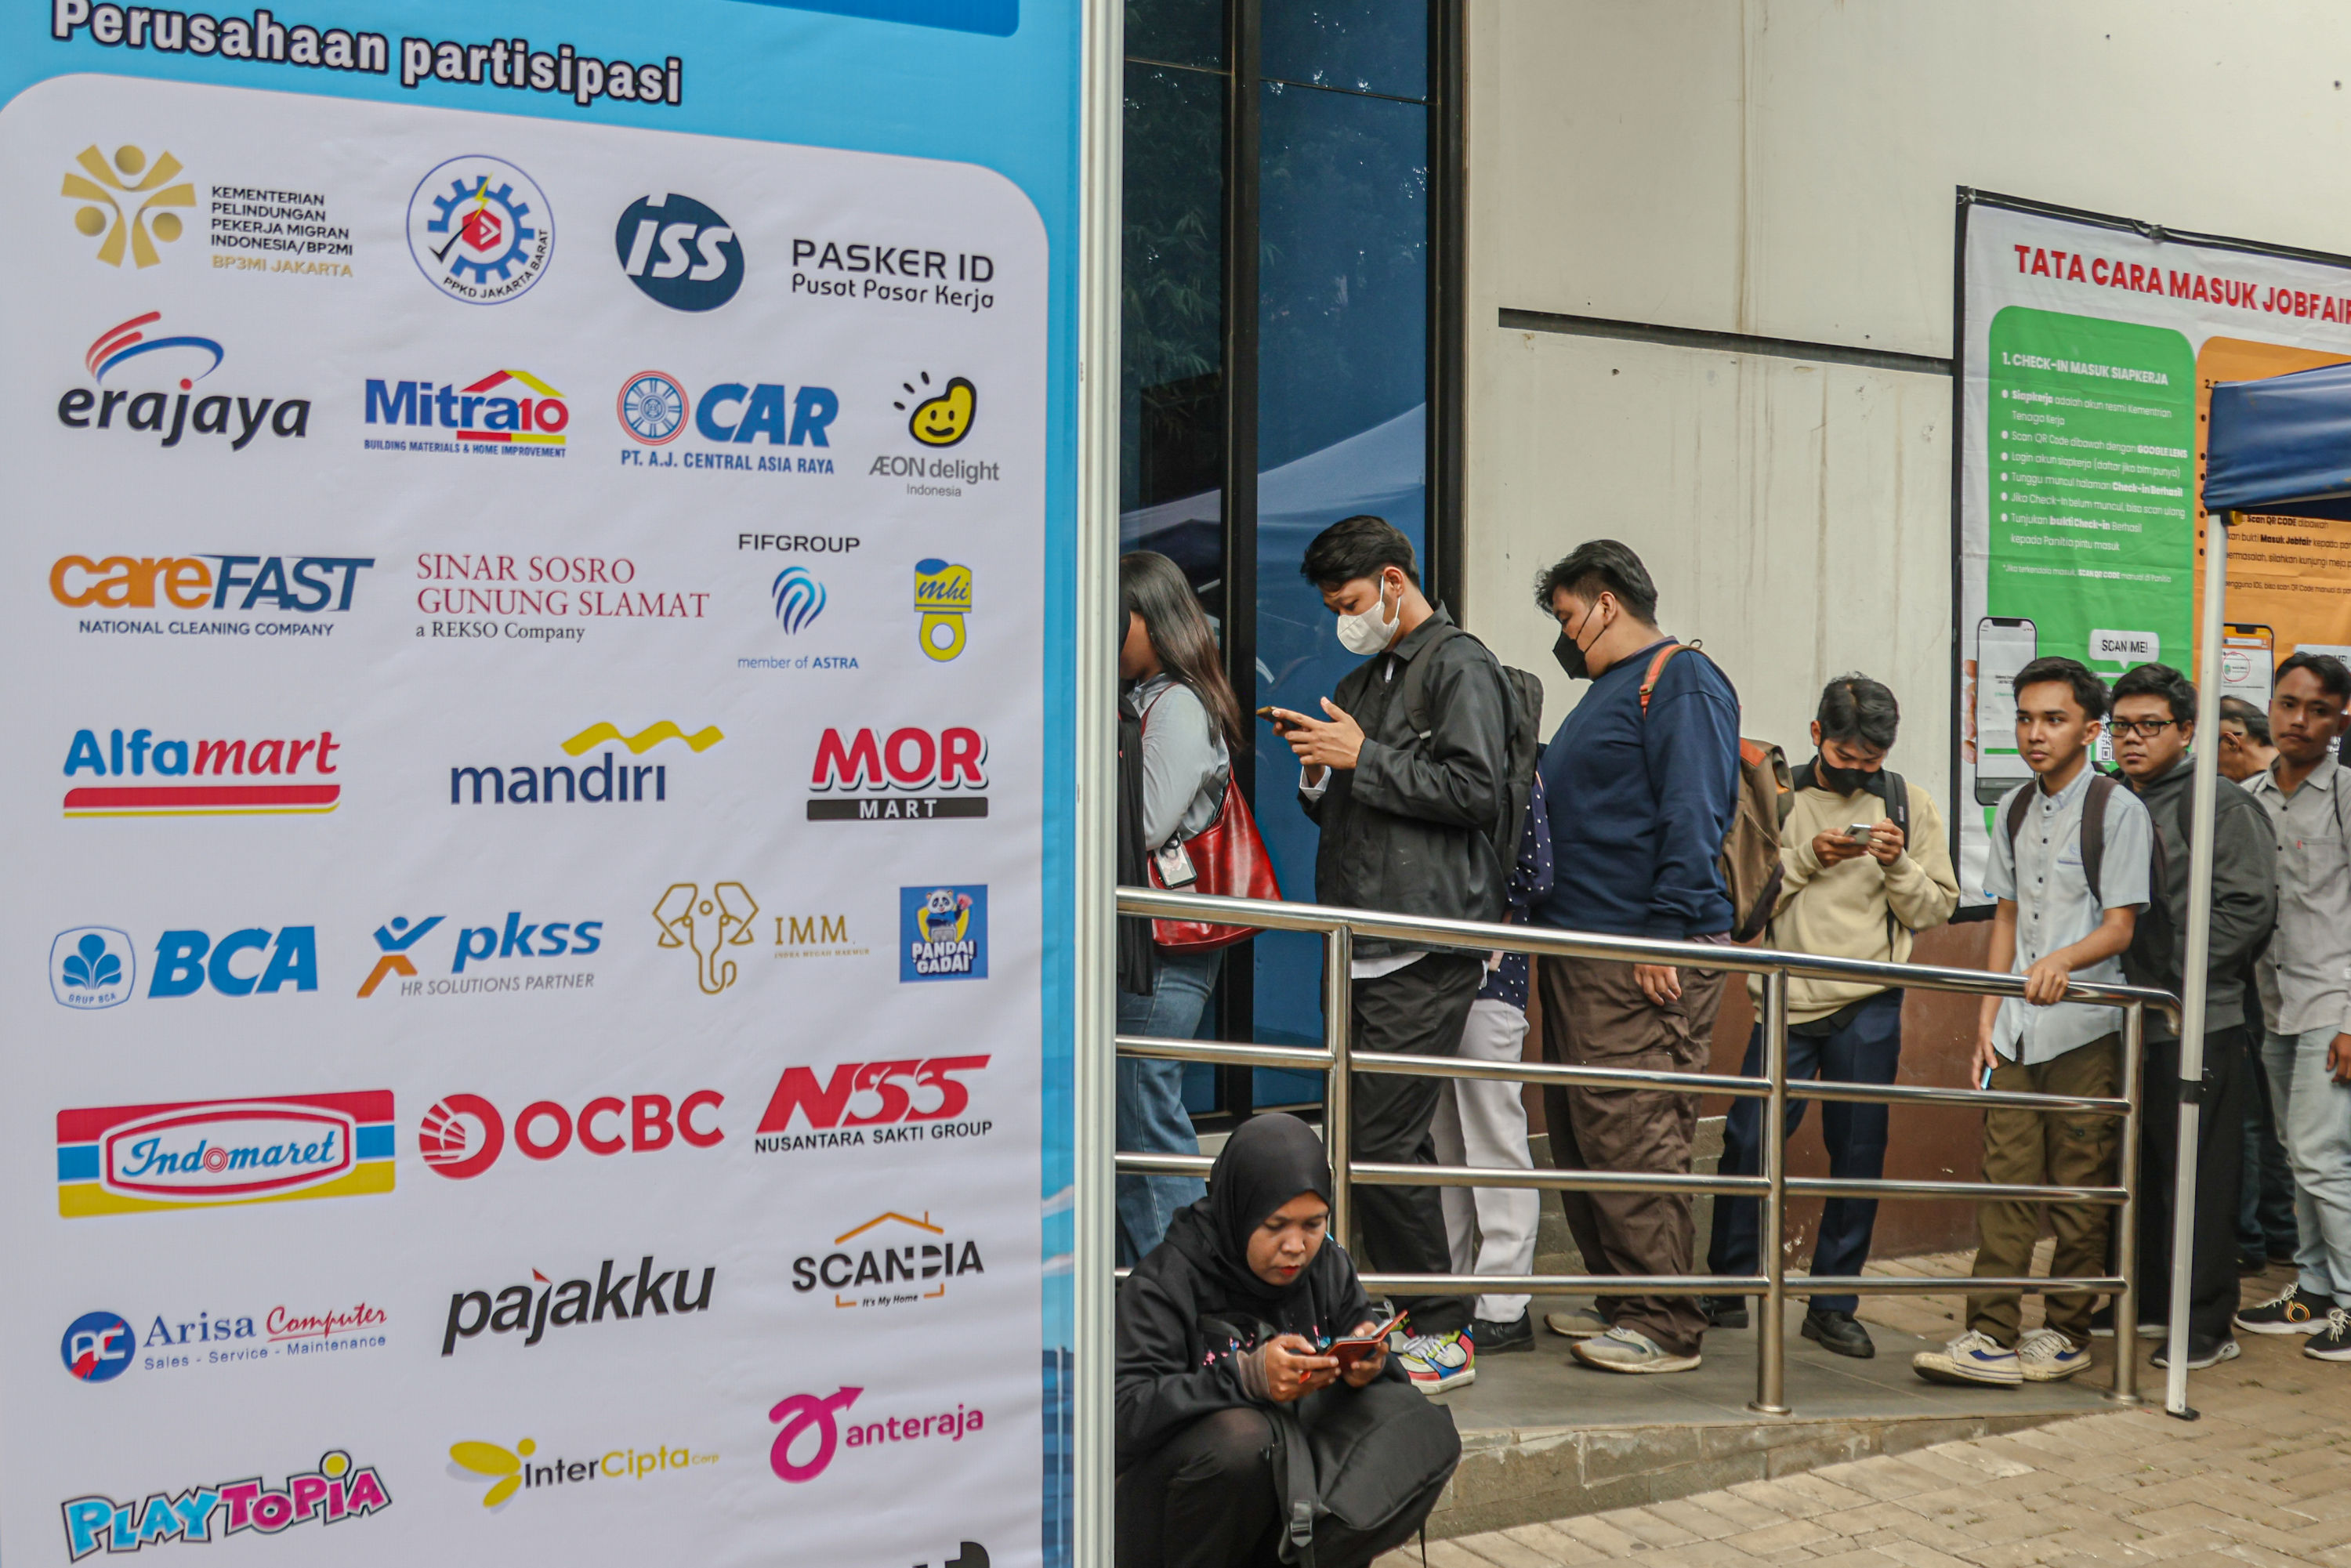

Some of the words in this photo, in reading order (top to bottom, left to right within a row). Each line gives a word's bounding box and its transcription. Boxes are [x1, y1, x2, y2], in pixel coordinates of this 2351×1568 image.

[52, 0, 388, 72] Perusahaan
[402, 38, 682, 106] partisipasi
[211, 185, 324, 206] KEMENTERIAN
[211, 201, 326, 223] PELINDUNGAN
[211, 218, 283, 237] PEKERJA
[286, 222, 350, 241] MIGRAN
[211, 234, 353, 257] INDONESIA/BP2MI
[212, 255, 266, 272] BP3MI
[270, 257, 353, 278] JAKARTA
[443, 275, 479, 299] PPKD
[480, 270, 533, 299] JAKARTA
[531, 229, 549, 271] BARAT
[792, 238, 946, 280] PASKER
[958, 253, 994, 283] ID
[2014, 244, 2086, 283] TATA
[2092, 258, 2164, 295] CARA
[2170, 270, 2258, 310] MASUK
[791, 273, 857, 298] Pusat
[864, 280, 928, 305] Pasar
[935, 285, 994, 313] Kerja
[2002, 352, 2011, 365] 1.
[2012, 353, 2069, 373] CHECK-IN
[2070, 360, 2110, 378] MASUK
[2112, 366, 2168, 386] SIAPKERJA
[57, 378, 311, 451] erajaya
[365, 377, 569, 433] Mitra10
[695, 382, 839, 447] CAR
[2012, 389, 2053, 406] Siapkerja
[2055, 396, 2083, 407] adalah
[2085, 398, 2103, 410] akun
[2105, 403, 2127, 413] resmi
[2128, 404, 2172, 418] Kementrian
[2012, 411, 2045, 425] Tenaga
[2046, 415, 2065, 427] Kerja
[364, 440, 406, 451] BUILDING
[408, 441, 460, 454] MATERIALS
[462, 444, 469, 454] &
[473, 445, 498, 455] HOME
[502, 446, 566, 458] IMPROVEMENT
[2012, 432, 2033, 442] Scan
[2034, 433, 2047, 444] QR
[2049, 435, 2069, 446] Code
[2070, 437, 2105, 449] dibawah
[2106, 440, 2136, 454] dengan
[2137, 445, 2168, 457] GOOGLE
[2169, 448, 2188, 458] LENS
[621, 450, 642, 466] PT.
[649, 451, 679, 469] A.J.
[683, 453, 752, 471] CENTRAL
[757, 455, 792, 473] ASIA
[797, 458, 834, 475] RAYA
[929, 458, 999, 484] delight
[2012, 451, 2033, 465] Login
[2035, 454, 2056, 465] akun
[2058, 456, 2092, 470] siapkerja
[2094, 458, 2121, 471] (daftar
[2121, 462, 2136, 474] jika
[2154, 466, 2180, 479] punya)
[906, 483, 962, 498] Indonesia
[2012, 472, 2043, 486] Tunggu
[2045, 476, 2075, 487] muncul
[2076, 479, 2111, 490] halaman
[2112, 481, 2150, 494] Check-in
[2150, 485, 2183, 498] Berhasil
[2012, 492, 2028, 503] Jika
[2069, 497, 2092, 509] belum
[2094, 500, 2124, 512] muncul,
[2126, 502, 2143, 513] bisa
[2143, 505, 2162, 515] scan
[2164, 506, 2186, 520] ulang
[2012, 512, 2048, 527] Tunjukan
[2049, 515, 2074, 527] bukti
[2074, 517, 2110, 531] Check-in
[2111, 521, 2142, 533] Berhasil
[2247, 515, 2266, 524] Scan
[2266, 516, 2277, 525] QR
[2277, 516, 2297, 527] CODE
[2298, 519, 2328, 529] dibawah
[738, 534, 860, 554] FIFGROUP
[2011, 533, 2042, 545] kepada
[2044, 534, 2074, 547] Panitia
[2075, 538, 2093, 550] pintu
[2094, 541, 2120, 552] masuk
[2241, 533, 2259, 542] bukti
[2260, 534, 2287, 544] Masuk
[2289, 536, 2312, 546] Jobfair
[2313, 538, 2338, 550] kepada
[417, 552, 518, 582] SINAR
[529, 555, 635, 585] SOSRO
[2269, 552, 2298, 563] silahkan
[2299, 555, 2327, 568] kunjungi
[2329, 559, 2346, 569] meja
[917, 574, 969, 602] mhi
[417, 587, 568, 616] GUNUNG
[578, 592, 710, 618] SLAMAT
[78, 620, 165, 635] NATIONAL
[168, 622, 250, 636] CLEANING
[255, 623, 334, 636] COMPANY
[415, 626, 425, 637] a
[431, 622, 498, 639] REKSO
[504, 621, 585, 643] Company
[2102, 639, 2127, 653] SCAN
[2130, 641, 2149, 654] ME!
[737, 657, 791, 670] member
[795, 656, 809, 670] of
[812, 656, 859, 670] ASTRA
[63, 728, 340, 777] Alfamart
[810, 726, 987, 790] MOR
[451, 752, 665, 805] mandiri
[860, 798, 938, 820] MART
[451, 911, 603, 973] pkss
[774, 915, 848, 946] IMM
[147, 925, 318, 999] BCA
[911, 940, 974, 961] PANDAI
[915, 957, 971, 975] GADAI
[68, 993, 95, 1004] GRUP
[98, 992, 117, 1004] BCA
[400, 981, 422, 997] HR
[426, 975, 520, 995] SOLUTIONS
[526, 973, 594, 992] PARTNER
[514, 1090, 725, 1161] OCBC
[755, 1132, 864, 1154] NUSANTARA
[873, 1125, 924, 1143] SAKTI
[931, 1121, 992, 1140] GROUP
[121, 1131, 335, 1177] Indomaret
[791, 1240, 984, 1293] SCANDIA
[441, 1256, 715, 1356] pajakku
[862, 1297, 875, 1307] It's
[878, 1295, 890, 1306] My
[893, 1293, 918, 1306] Home
[143, 1312, 256, 1348] Arisa
[266, 1303, 387, 1335] Computer
[143, 1356, 189, 1371] Sales
[208, 1347, 267, 1364] Service
[287, 1335, 386, 1356] Maintenance
[846, 1403, 984, 1447] anteraja
[525, 1446, 689, 1488] InterCipta
[691, 1453, 719, 1465] Corp
